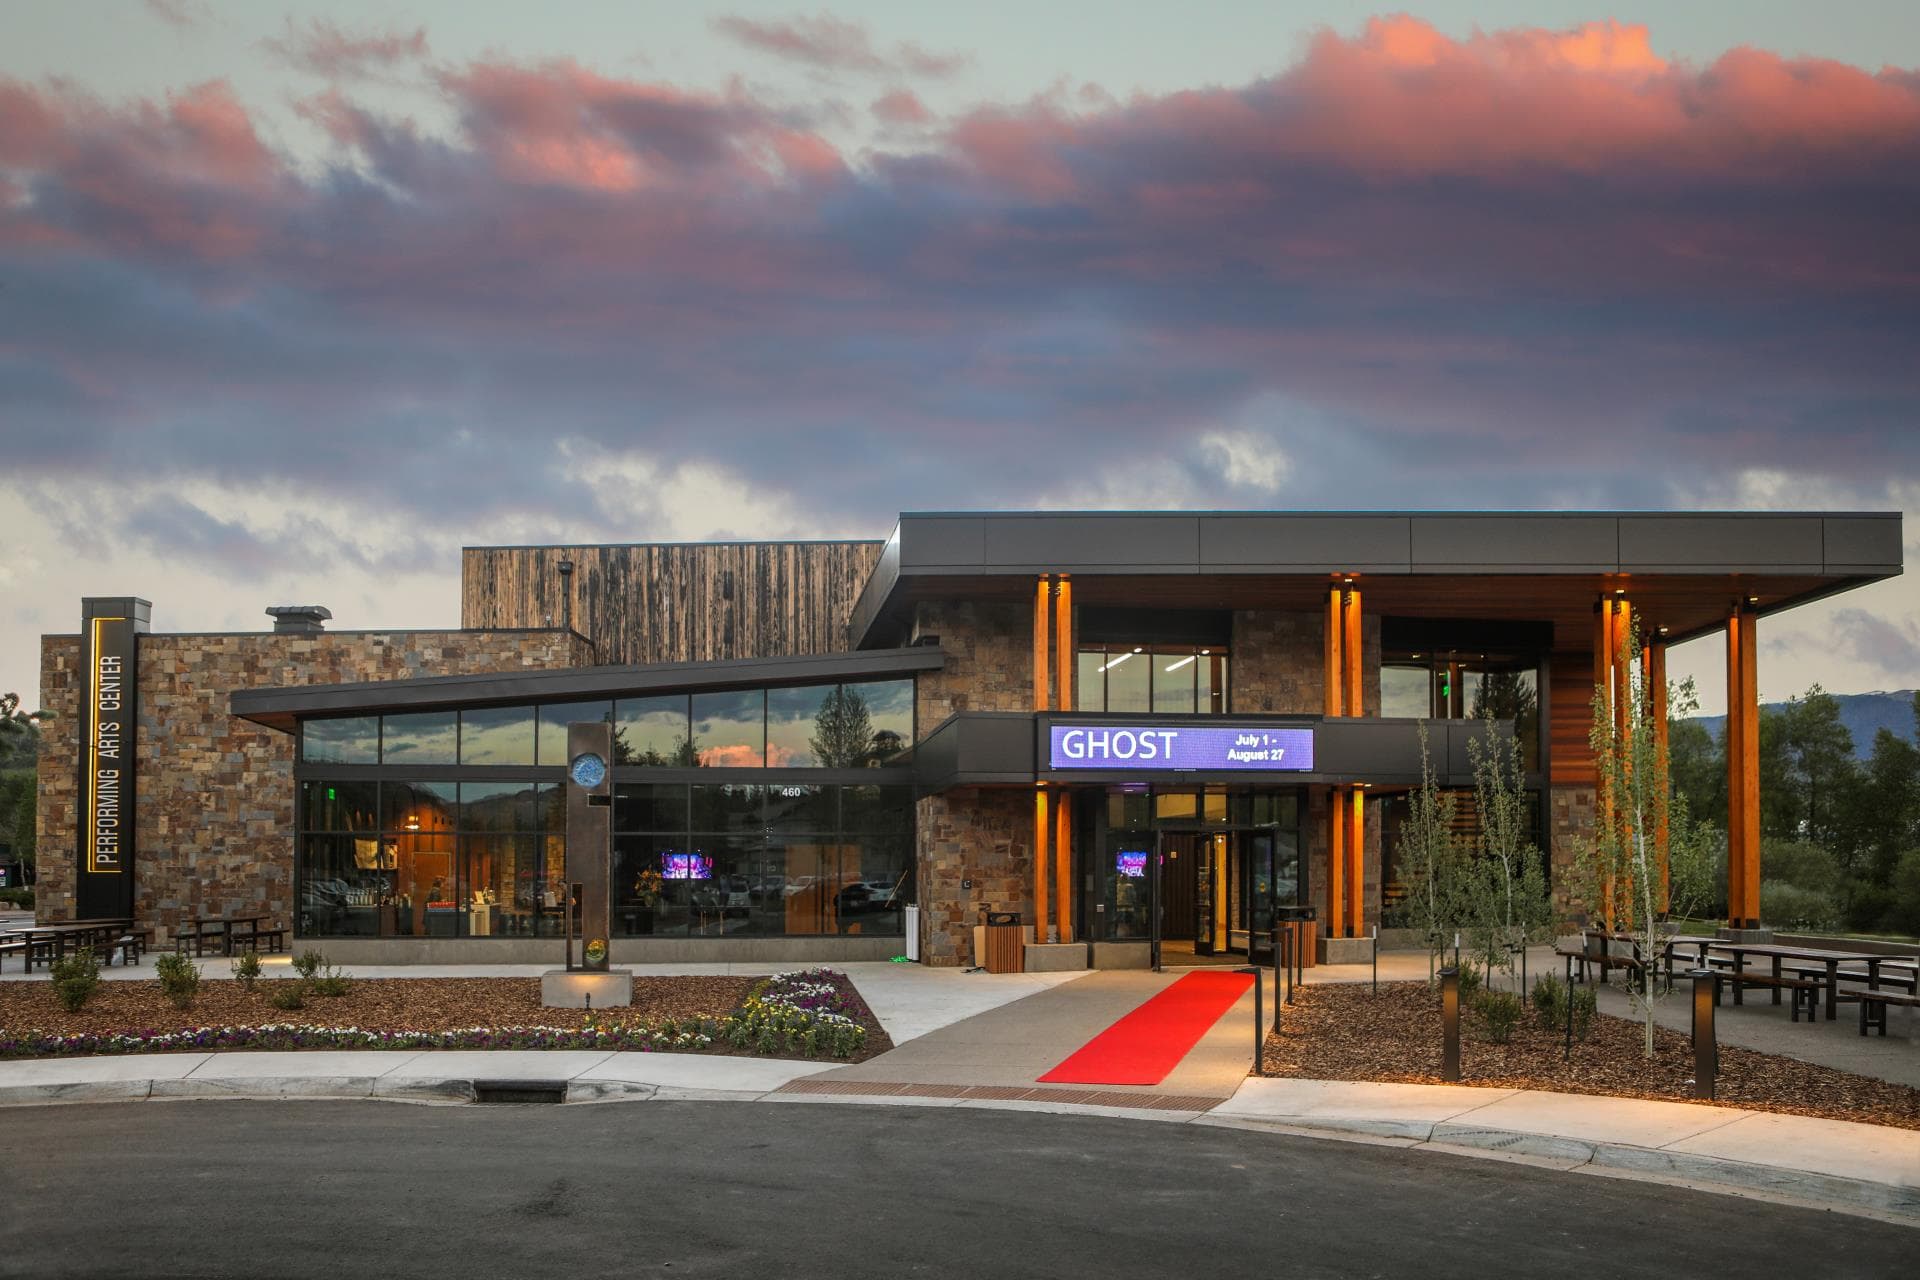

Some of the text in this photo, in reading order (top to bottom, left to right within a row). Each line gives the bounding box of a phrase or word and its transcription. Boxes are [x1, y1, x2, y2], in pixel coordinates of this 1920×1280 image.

[1062, 730, 1178, 759] GHOST
[1235, 734, 1260, 748] July
[1263, 734, 1269, 746] 1
[96, 656, 121, 863] PERFORMING ARTS CENTER
[1227, 748, 1285, 762] August 27
[782, 787, 801, 797] 460
